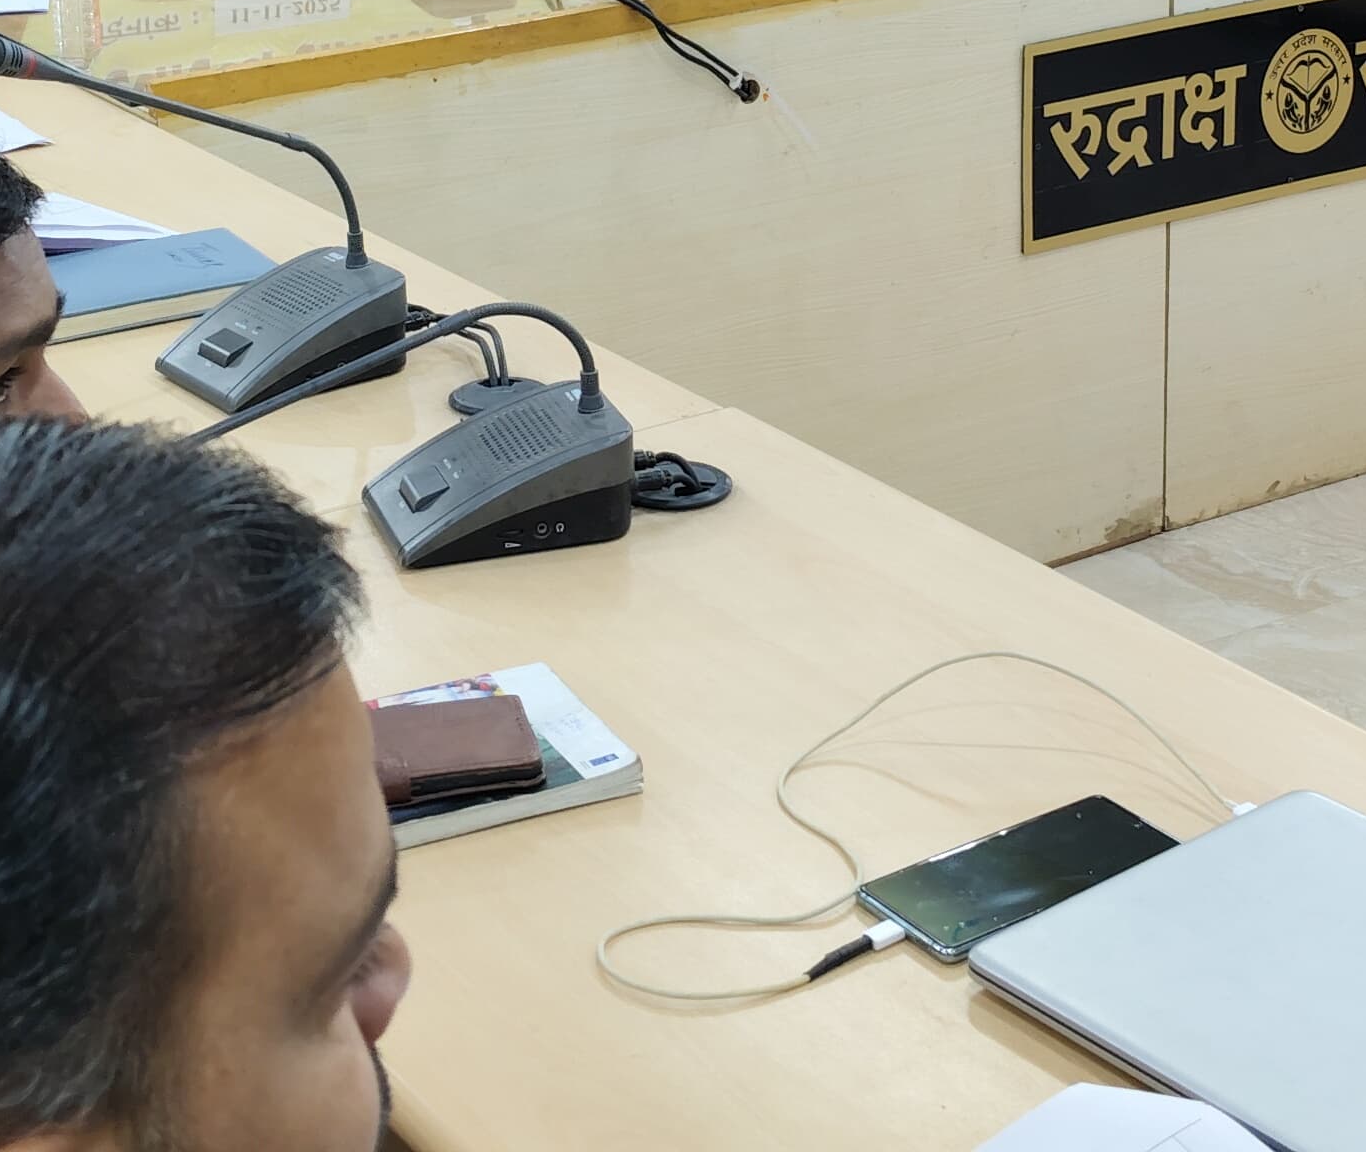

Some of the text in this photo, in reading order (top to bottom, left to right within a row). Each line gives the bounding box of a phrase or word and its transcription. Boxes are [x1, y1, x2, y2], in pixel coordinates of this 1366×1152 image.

[1291, 33, 1318, 52] प्रदेश
[1322, 34, 1348, 65] सरकार
[1042, 63, 1248, 180] रुद्राक्ष
